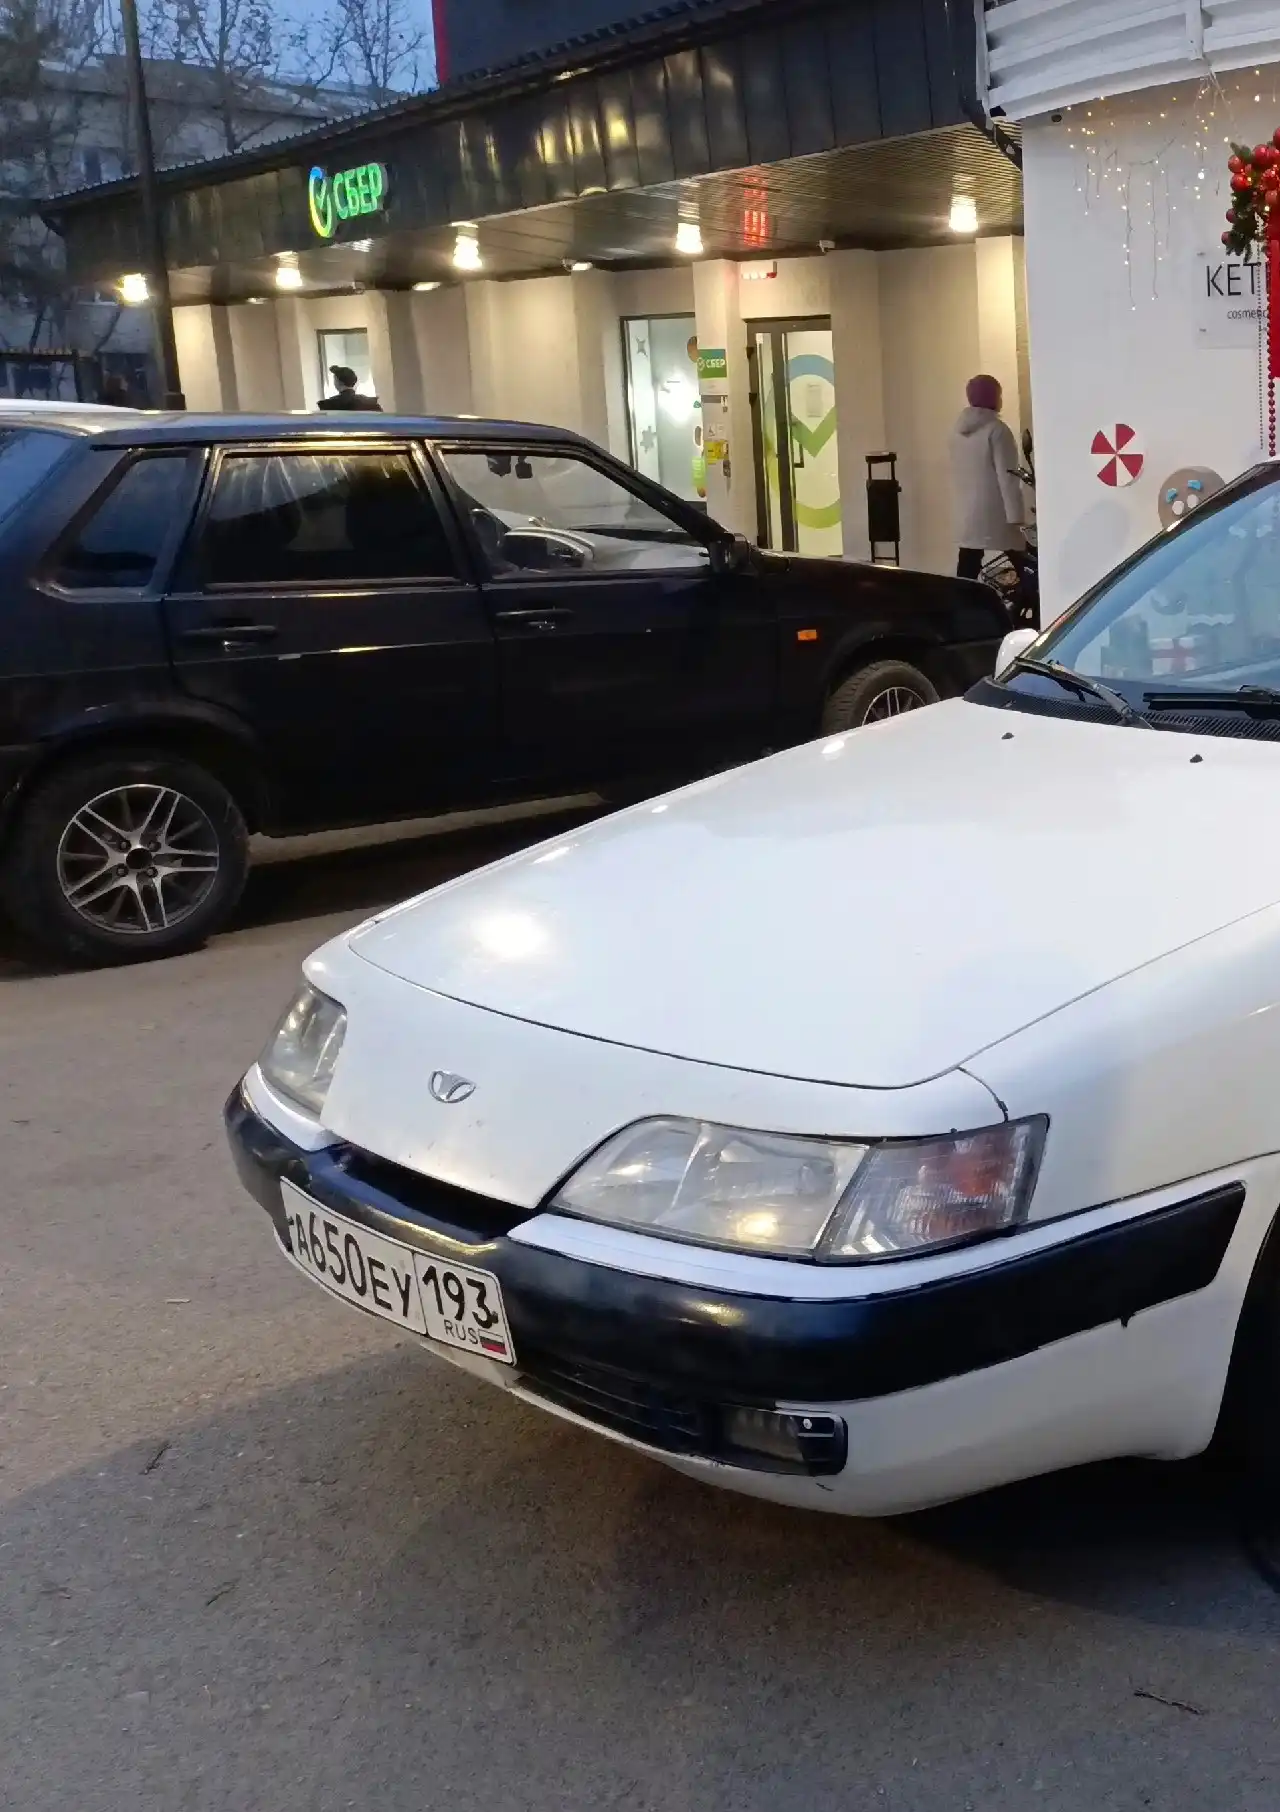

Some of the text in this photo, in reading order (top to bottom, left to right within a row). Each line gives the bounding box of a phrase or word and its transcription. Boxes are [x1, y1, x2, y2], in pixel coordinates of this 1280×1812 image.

[333, 163, 383, 219] СБЕР
[705, 358, 726, 369] СБЕР
[422, 1265, 494, 1330] 193
[443, 1319, 479, 1345] RUS
